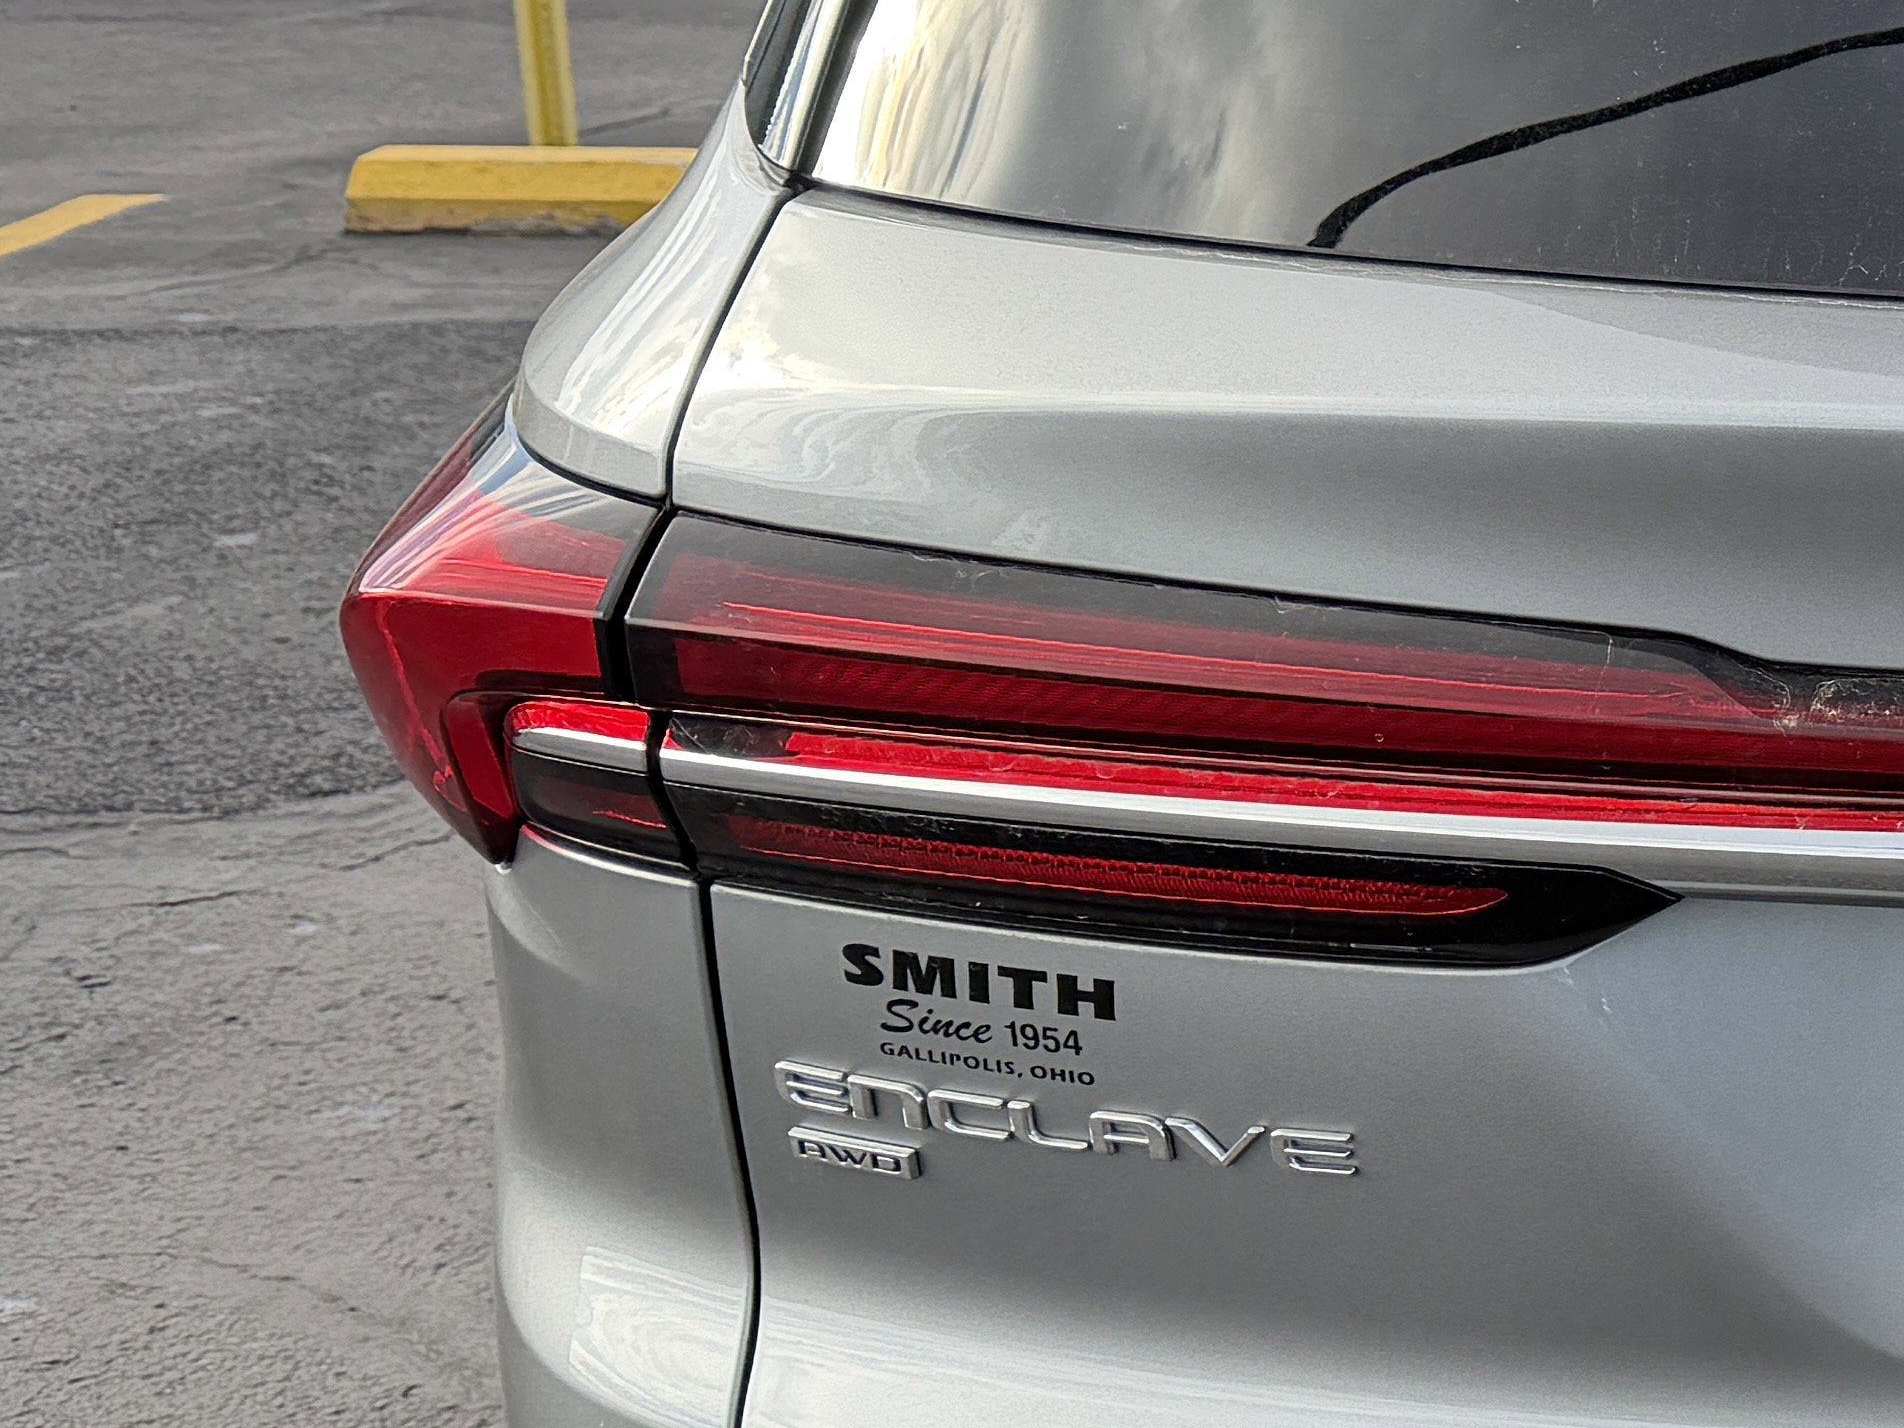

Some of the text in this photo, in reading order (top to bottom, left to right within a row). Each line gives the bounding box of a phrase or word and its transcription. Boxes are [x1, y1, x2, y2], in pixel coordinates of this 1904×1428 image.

[841, 942, 1117, 1021] SMITH
[879, 998, 1084, 1057] Since 1954
[879, 1041, 1096, 1087] GALLIPOLIS, OHIO
[773, 1059, 1358, 1176] ENCLAVE
[798, 1137, 904, 1176] AWD
